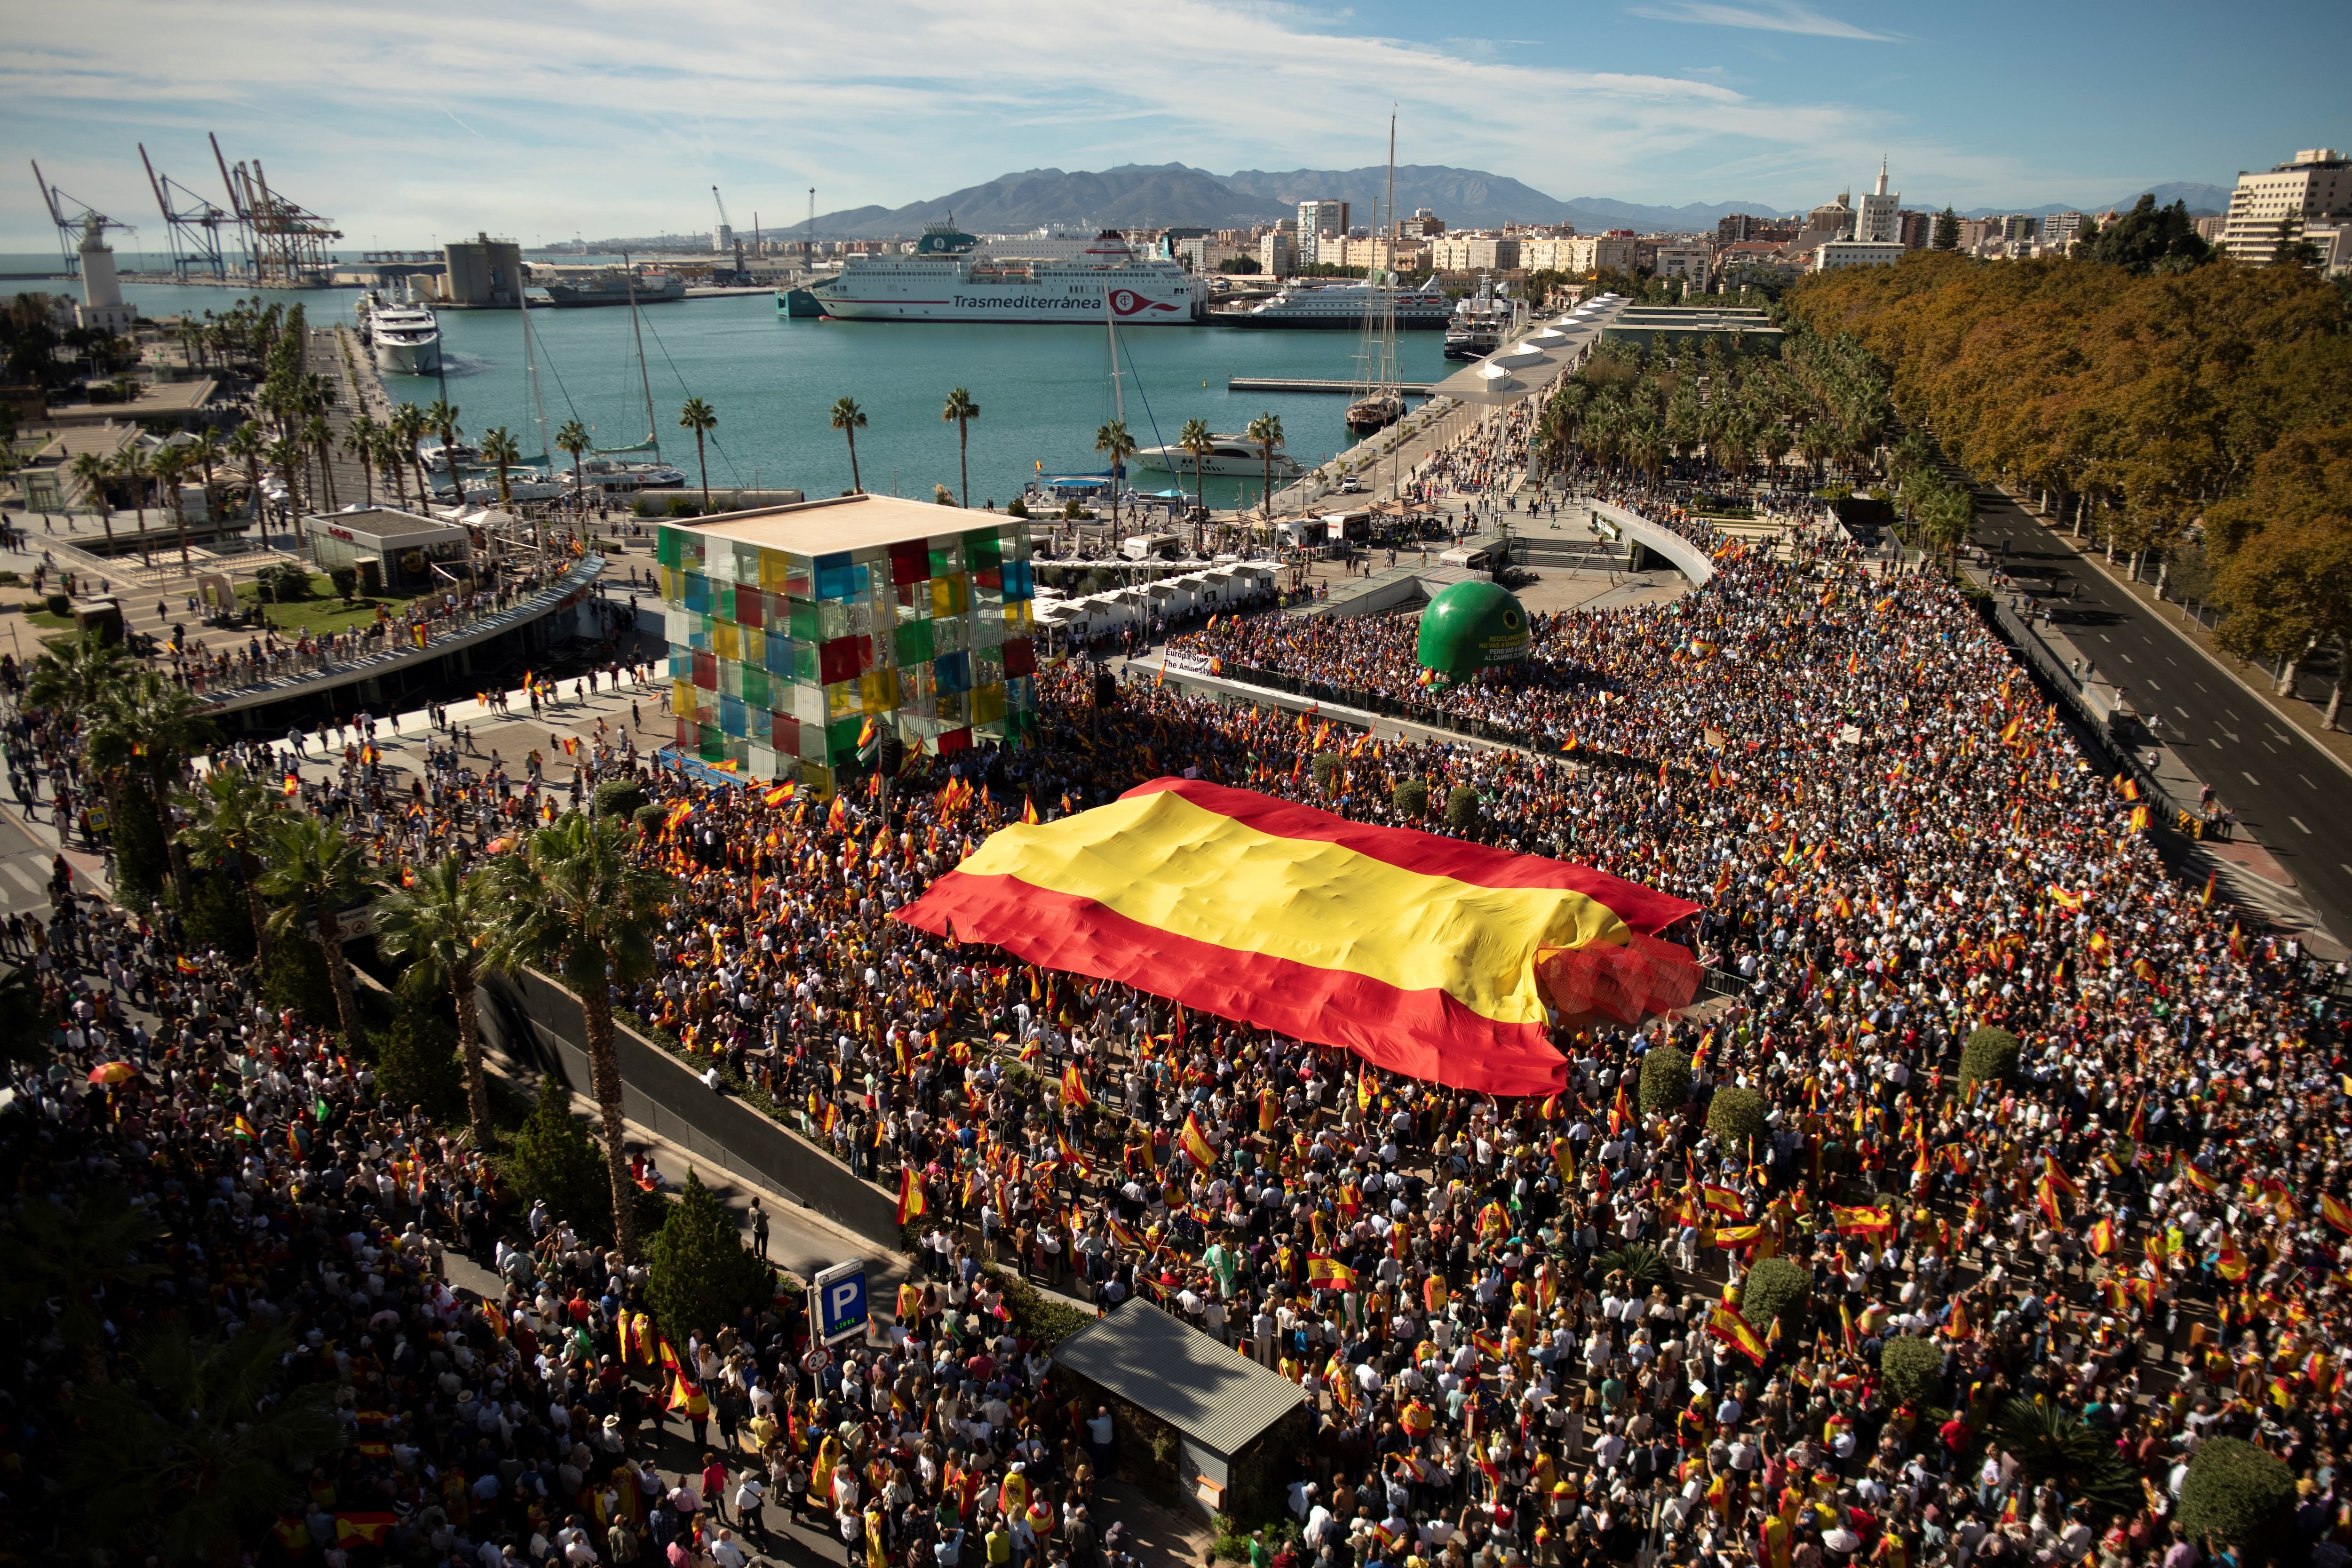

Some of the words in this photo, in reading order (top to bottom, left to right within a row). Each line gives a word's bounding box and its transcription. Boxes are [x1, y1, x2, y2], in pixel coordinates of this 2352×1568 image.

[953, 295, 1101, 309] Trasmediterránea
[1166, 648, 1190, 662] Europa
[1164, 660, 1177, 668] The
[1179, 662, 1210, 676] Amnesty
[830, 1265, 859, 1279] muelleuno
[832, 1282, 858, 1321] P
[835, 1318, 855, 1330] LIBRE
